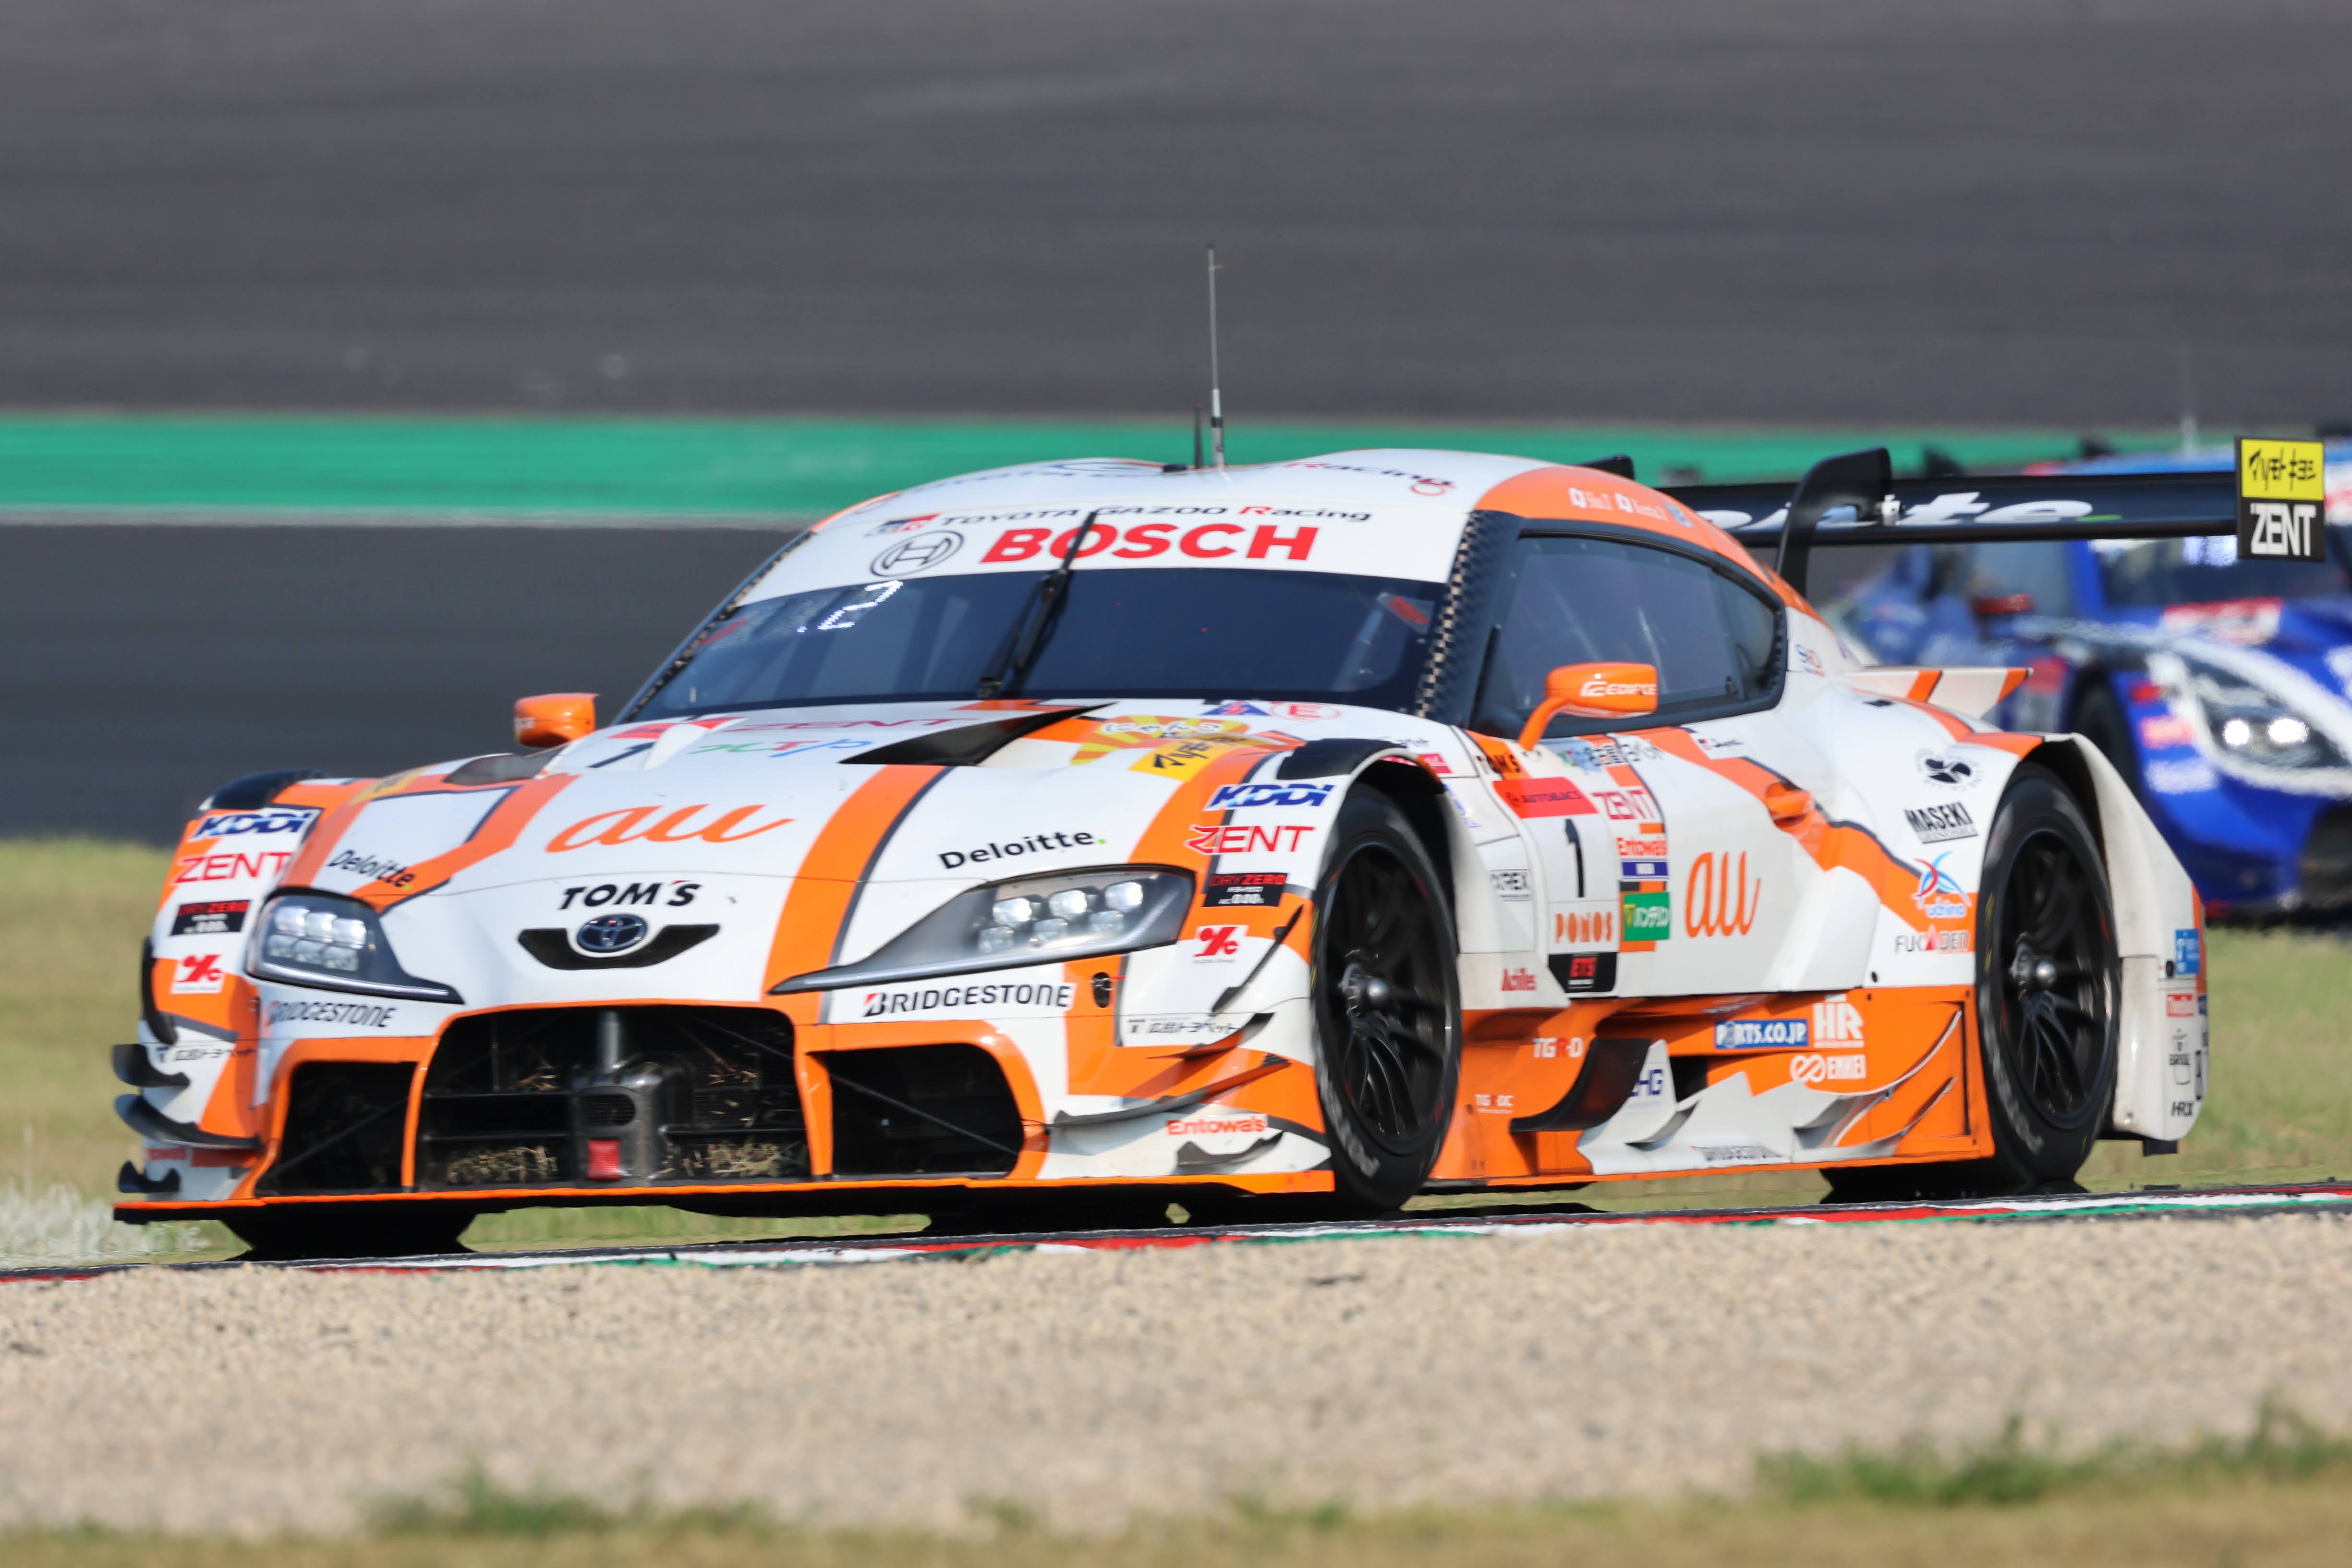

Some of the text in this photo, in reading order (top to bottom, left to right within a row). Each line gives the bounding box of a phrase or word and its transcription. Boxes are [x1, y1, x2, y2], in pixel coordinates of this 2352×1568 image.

[942, 509, 1080, 526] TOYOTA
[1093, 505, 1227, 517] GAZOO
[1238, 506, 1374, 522] Racing
[2250, 502, 2317, 557] ZENT
[979, 523, 1320, 563] BOSCH
[1206, 783, 1335, 810] KDDI
[1591, 789, 1657, 821] ZENT
[194, 812, 315, 839] KDDI
[545, 803, 797, 853] au
[1904, 801, 1974, 832] MASEKI
[938, 830, 1107, 870] Deloitte.
[1184, 825, 1315, 854] ZENT
[173, 851, 294, 884] ZENT
[1565, 819, 1587, 898] 1
[558, 879, 703, 910] TOM'S
[1685, 851, 1762, 938] au
[1555, 911, 1613, 944] PONOS
[862, 984, 1074, 1017] BRIDGESTONE
[1167, 1115, 1267, 1135] Entowa's
